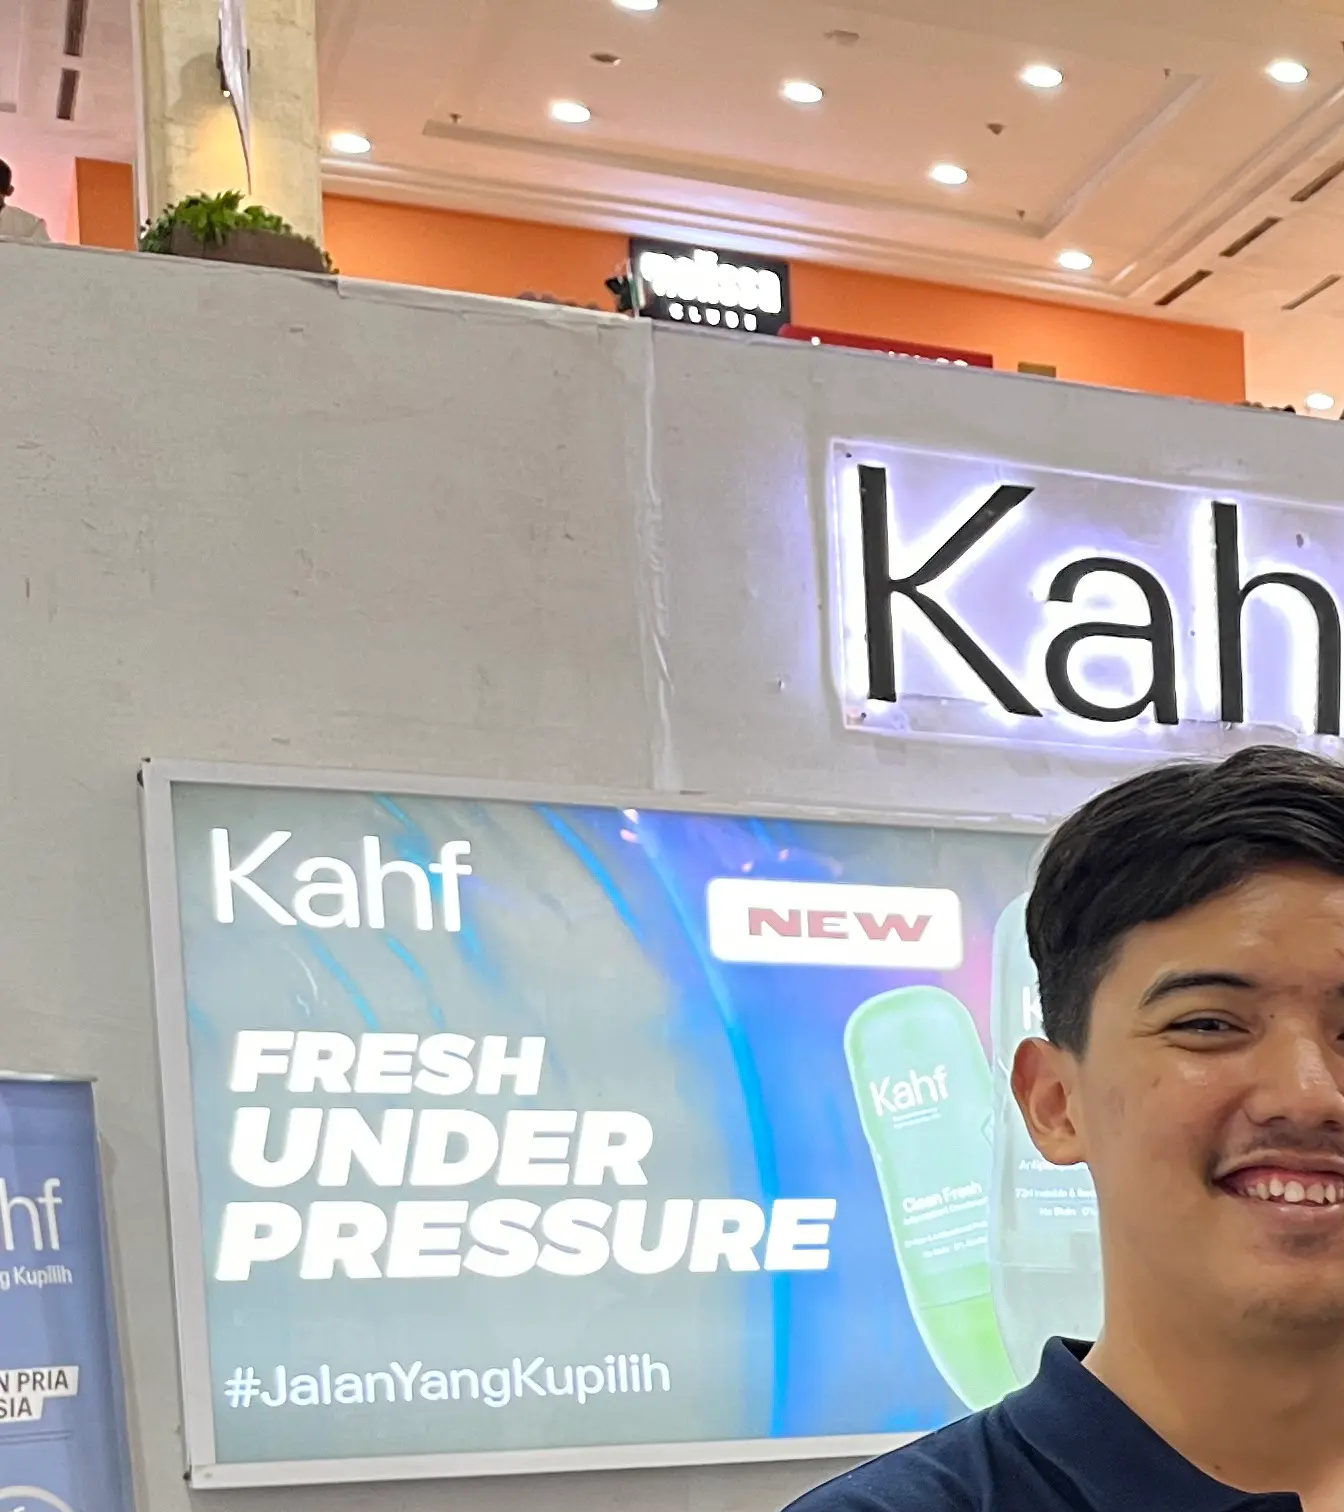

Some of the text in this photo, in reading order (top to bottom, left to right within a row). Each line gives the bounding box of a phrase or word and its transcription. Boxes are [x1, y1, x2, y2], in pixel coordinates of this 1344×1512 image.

[211, 827, 473, 933] Kahf
[747, 905, 934, 945] NEW
[227, 1029, 546, 1097] FRESH
[869, 1065, 949, 1116] Kahf
[229, 1106, 654, 1188] UNDER
[214, 1198, 838, 1283] PRESSURE
[17, 1369, 69, 1392] PRIA
[223, 1353, 671, 1409] #JalanYangKupilih
